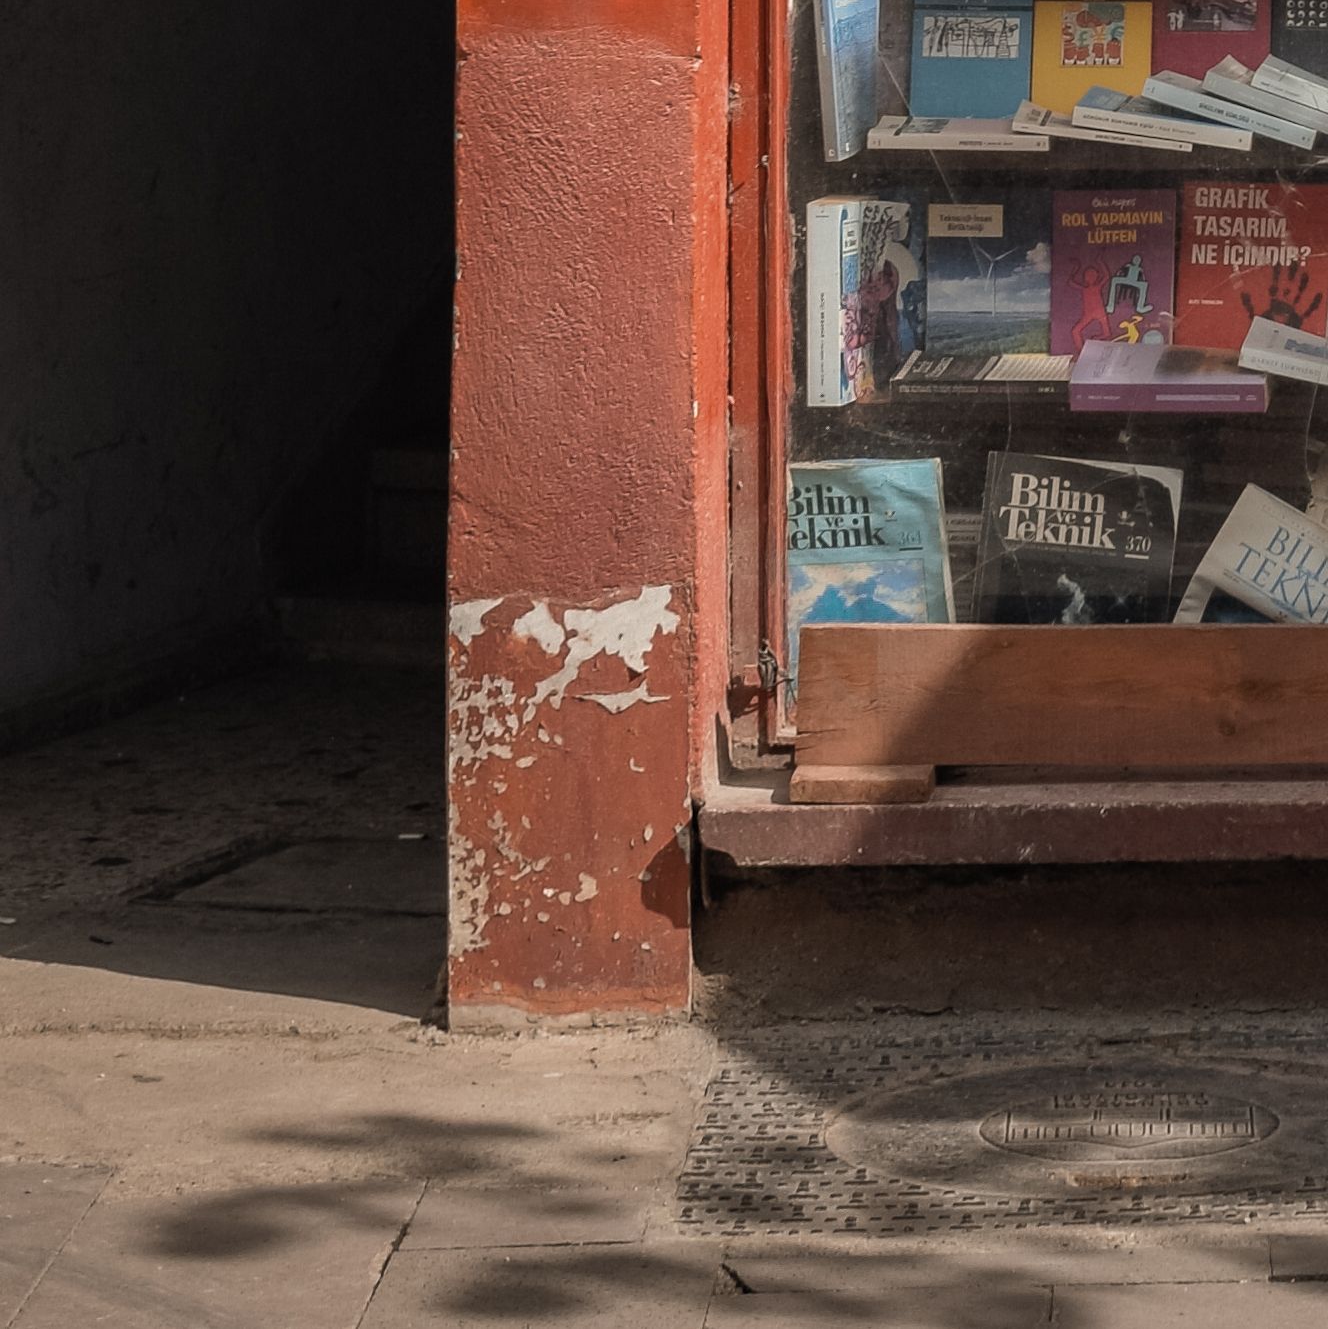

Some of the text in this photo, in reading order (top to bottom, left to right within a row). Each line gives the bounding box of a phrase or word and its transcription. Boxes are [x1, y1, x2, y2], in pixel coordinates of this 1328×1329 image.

[1194, 183, 1269, 209] GRAFİK
[1062, 211, 1164, 226] ROL YAPMAYIN
[1193, 214, 1287, 238] TASARIM
[1087, 227, 1137, 244] LÜTFEN
[1191, 242, 1312, 271] NE İÇİNDİR?
[1007, 473, 1105, 514] Bilim
[824, 515, 844, 528] ve
[1000, 506, 1117, 551] Teknik
[1056, 511, 1077, 526] ve
[1124, 534, 1152, 553] 370
